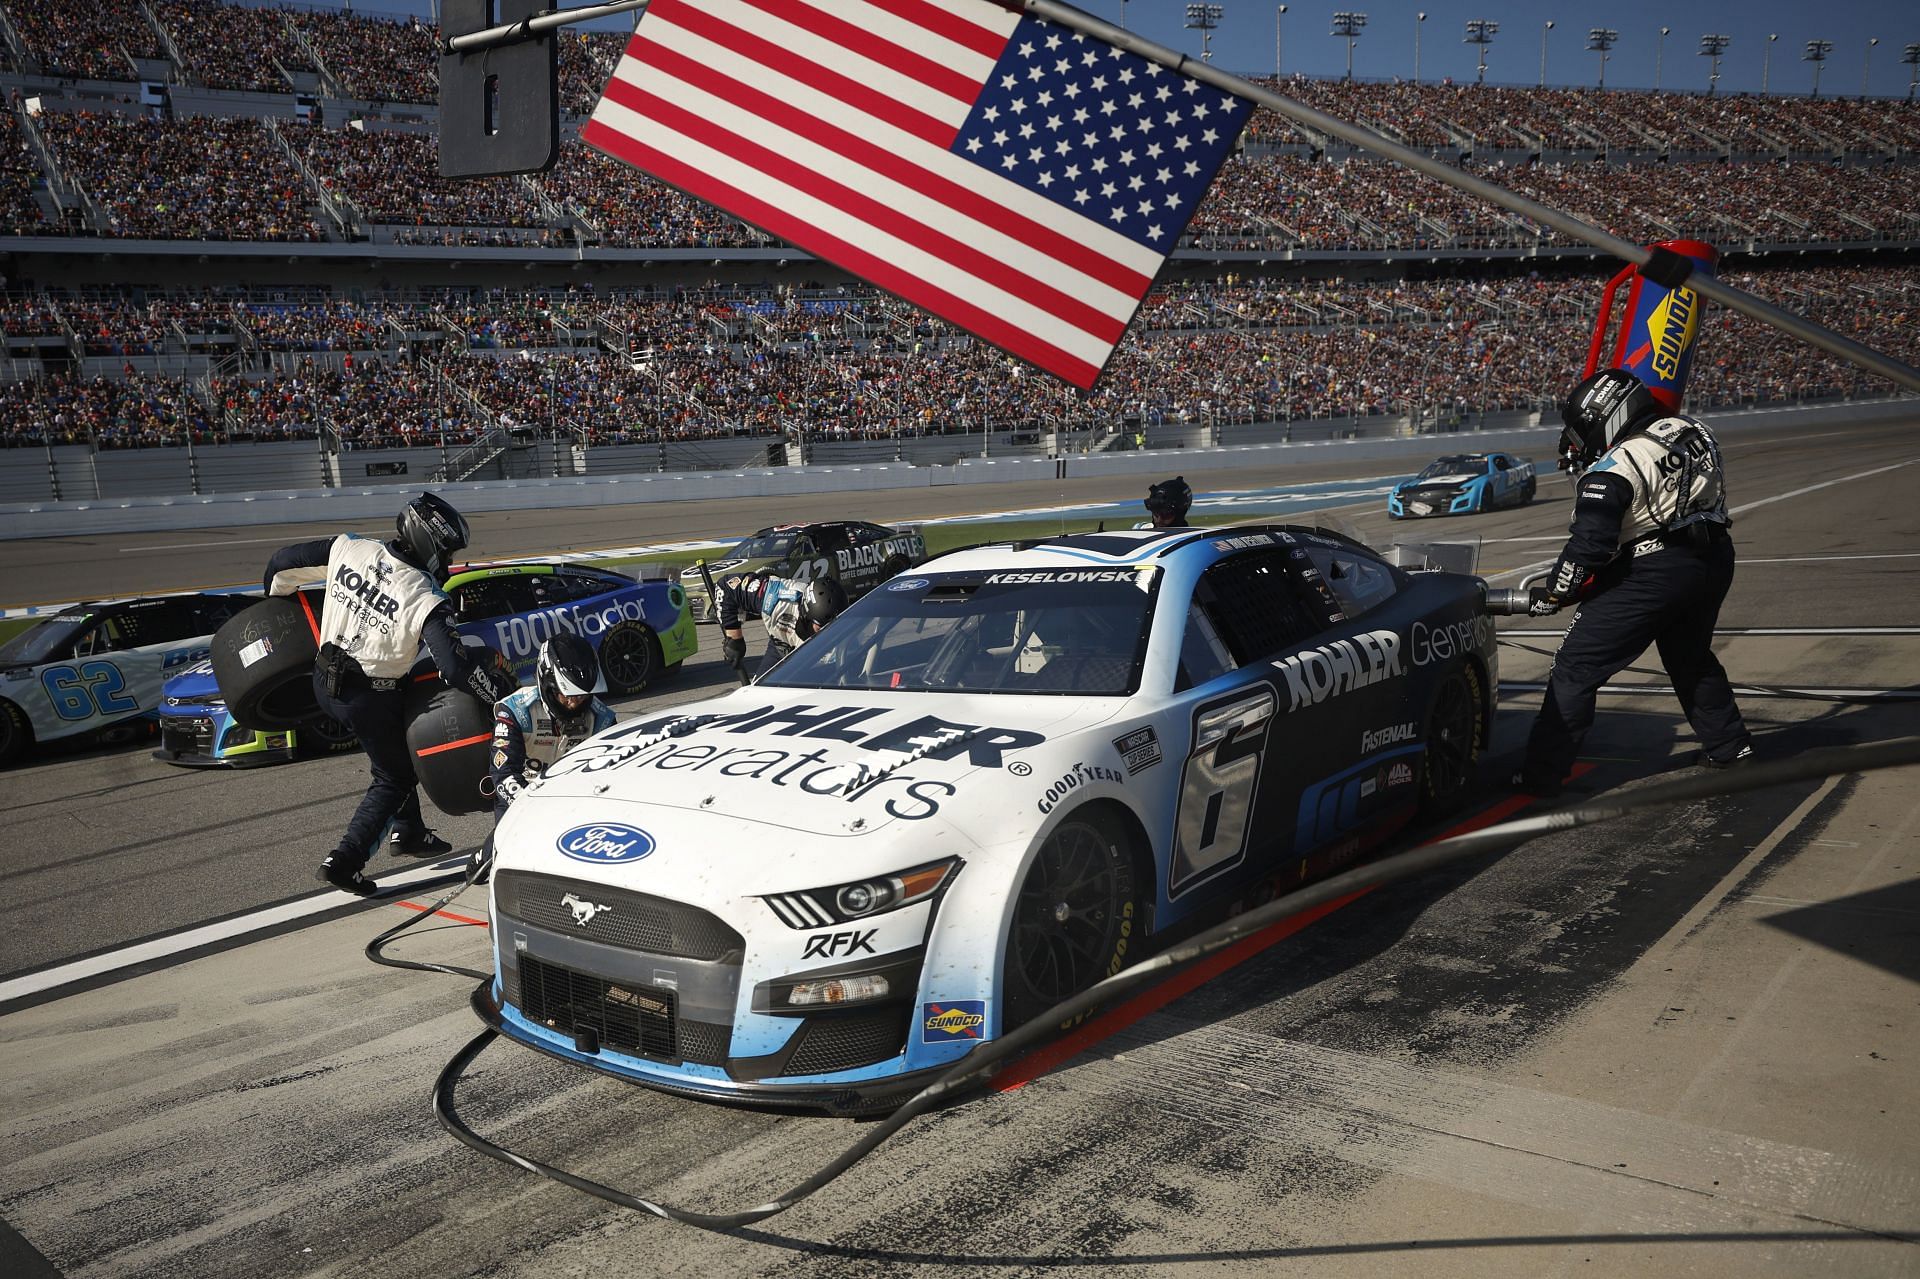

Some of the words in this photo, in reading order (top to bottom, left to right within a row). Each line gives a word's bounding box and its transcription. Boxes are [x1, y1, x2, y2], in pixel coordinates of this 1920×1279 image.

[1656, 286, 1694, 376] SUNOC
[791, 558, 830, 584] 42
[836, 543, 884, 571] BLACK
[884, 537, 920, 557] RIFLE
[840, 570, 856, 580] COFFEE
[856, 566, 879, 577] COMPANY
[331, 584, 390, 635] Generators
[335, 563, 399, 621] KOHLER
[494, 607, 576, 660] FOCUS
[573, 598, 646, 638] factor
[473, 665, 499, 701] KOHLE
[1270, 629, 1401, 713] KOHLER
[41, 660, 140, 721] 62
[1126, 729, 1150, 747] NASCAR
[1361, 721, 1417, 754] FASTENAL
[1127, 751, 1138, 766] CUP
[1137, 746, 1155, 762] SERIES
[540, 743, 957, 821] Generators
[1169, 686, 1276, 896] 6
[800, 928, 880, 960] RFK
[928, 1014, 980, 1028] SUNOCO
